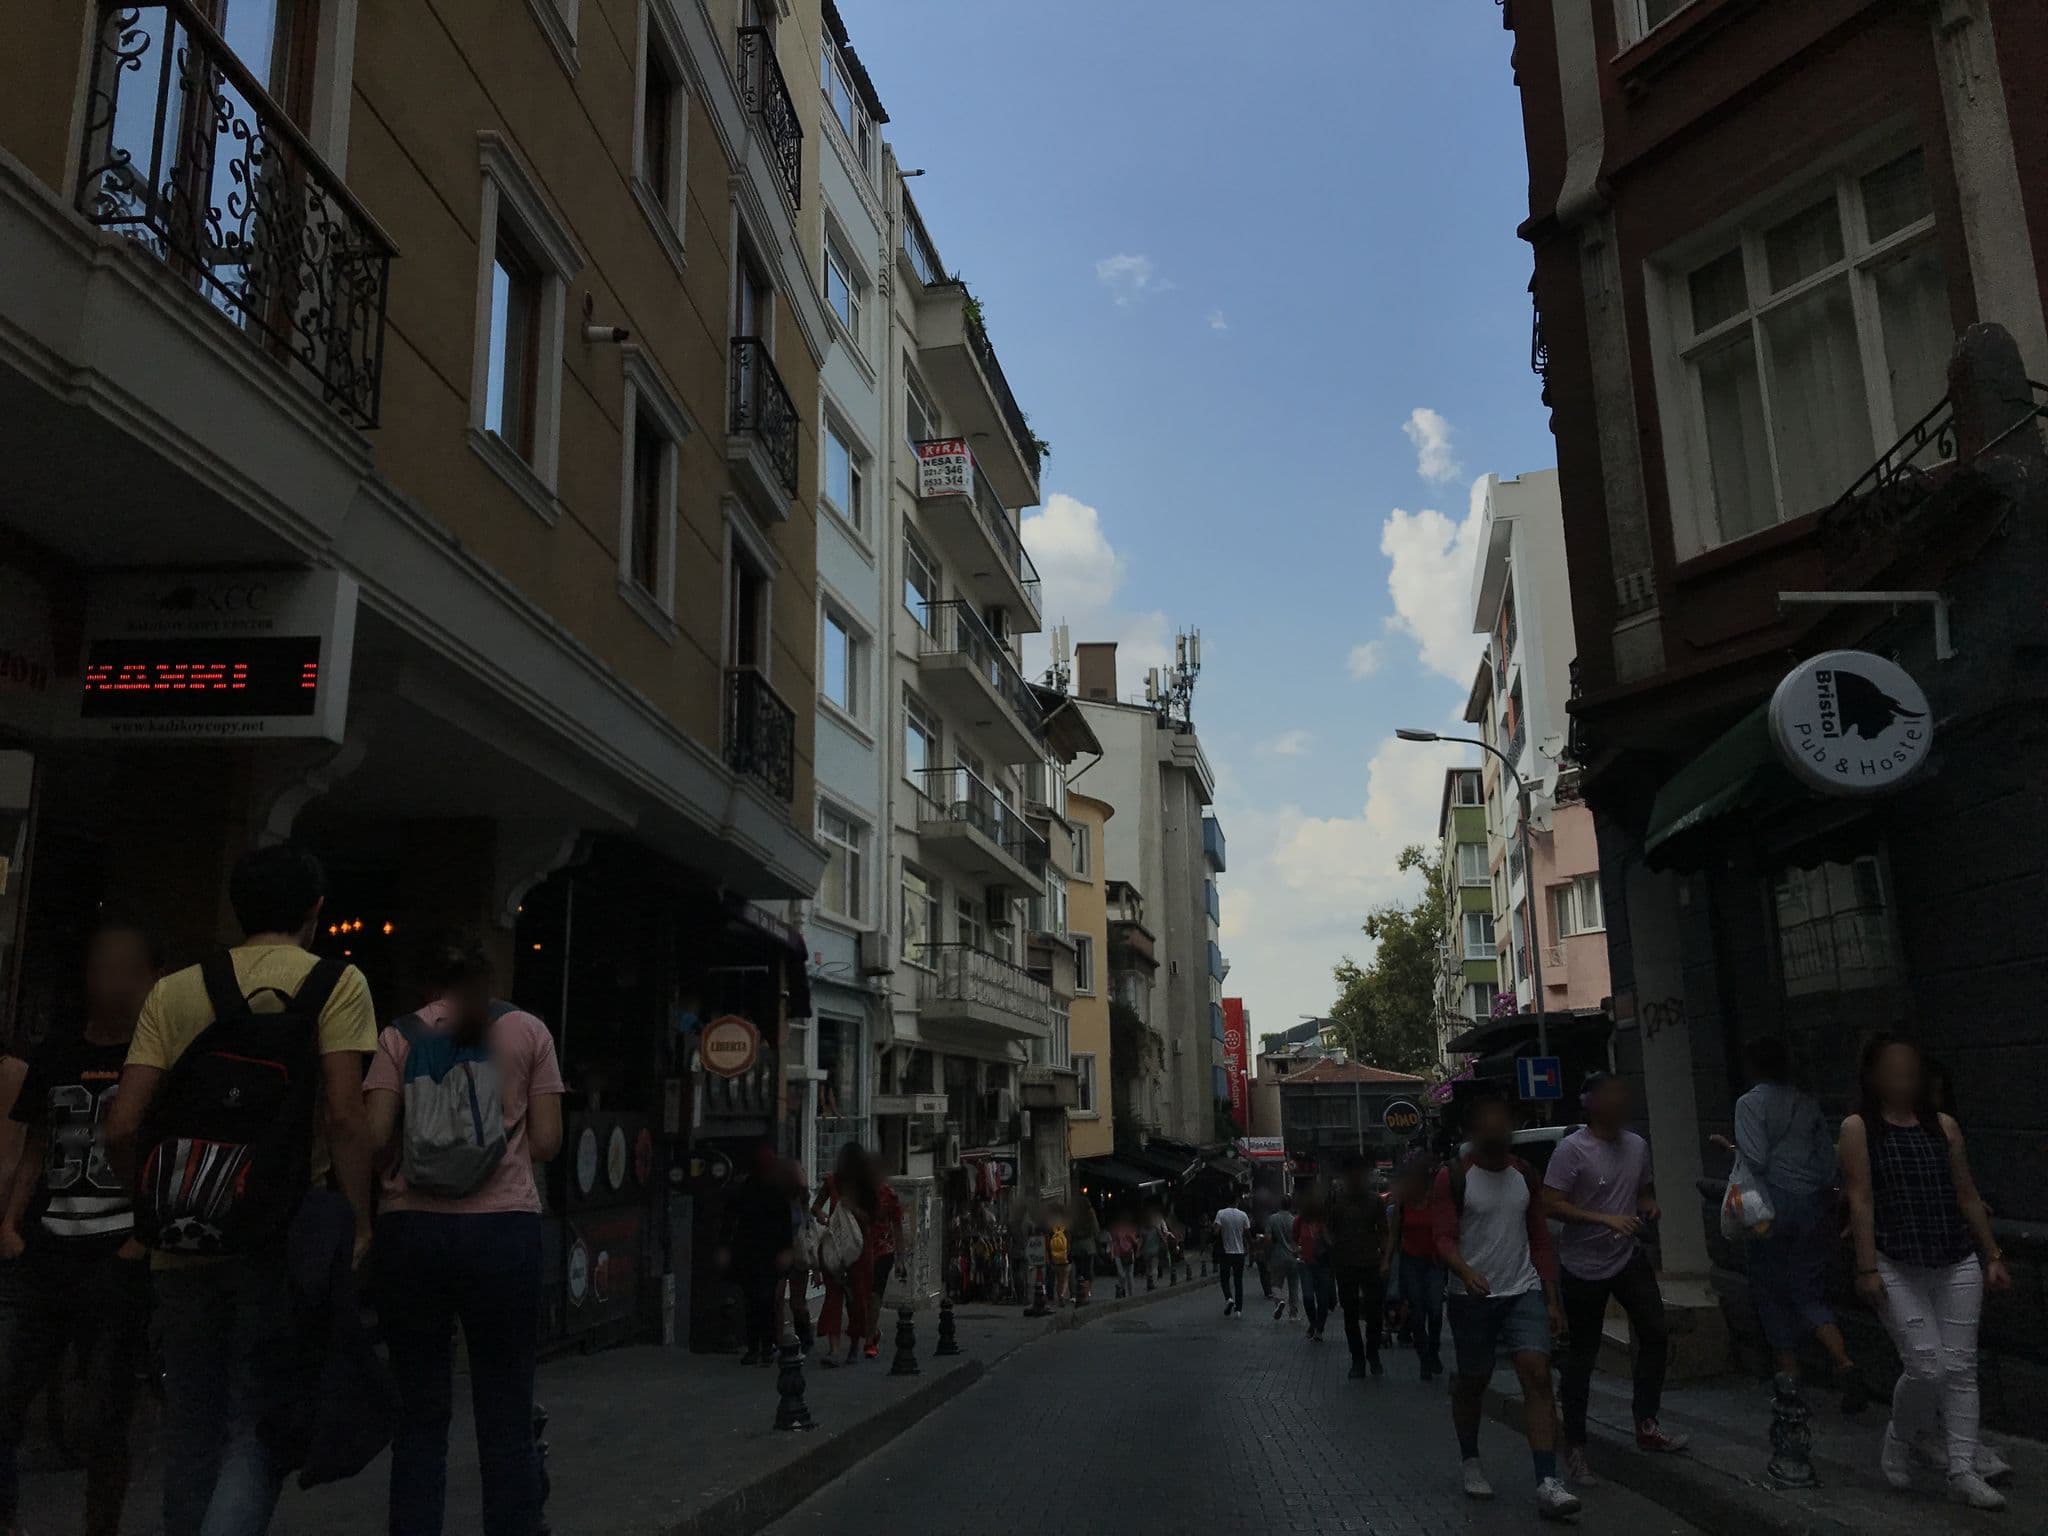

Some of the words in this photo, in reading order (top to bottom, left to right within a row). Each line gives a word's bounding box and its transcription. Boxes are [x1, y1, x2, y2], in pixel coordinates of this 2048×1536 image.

[923, 457, 952, 467] NESA
[945, 465, 963, 475] 346
[945, 476, 963, 485] 314
[1816, 670, 1840, 738] Bristol
[1794, 722, 1826, 762] Pub
[1835, 758, 1849, 774] &
[1860, 720, 1923, 775] Hostel
